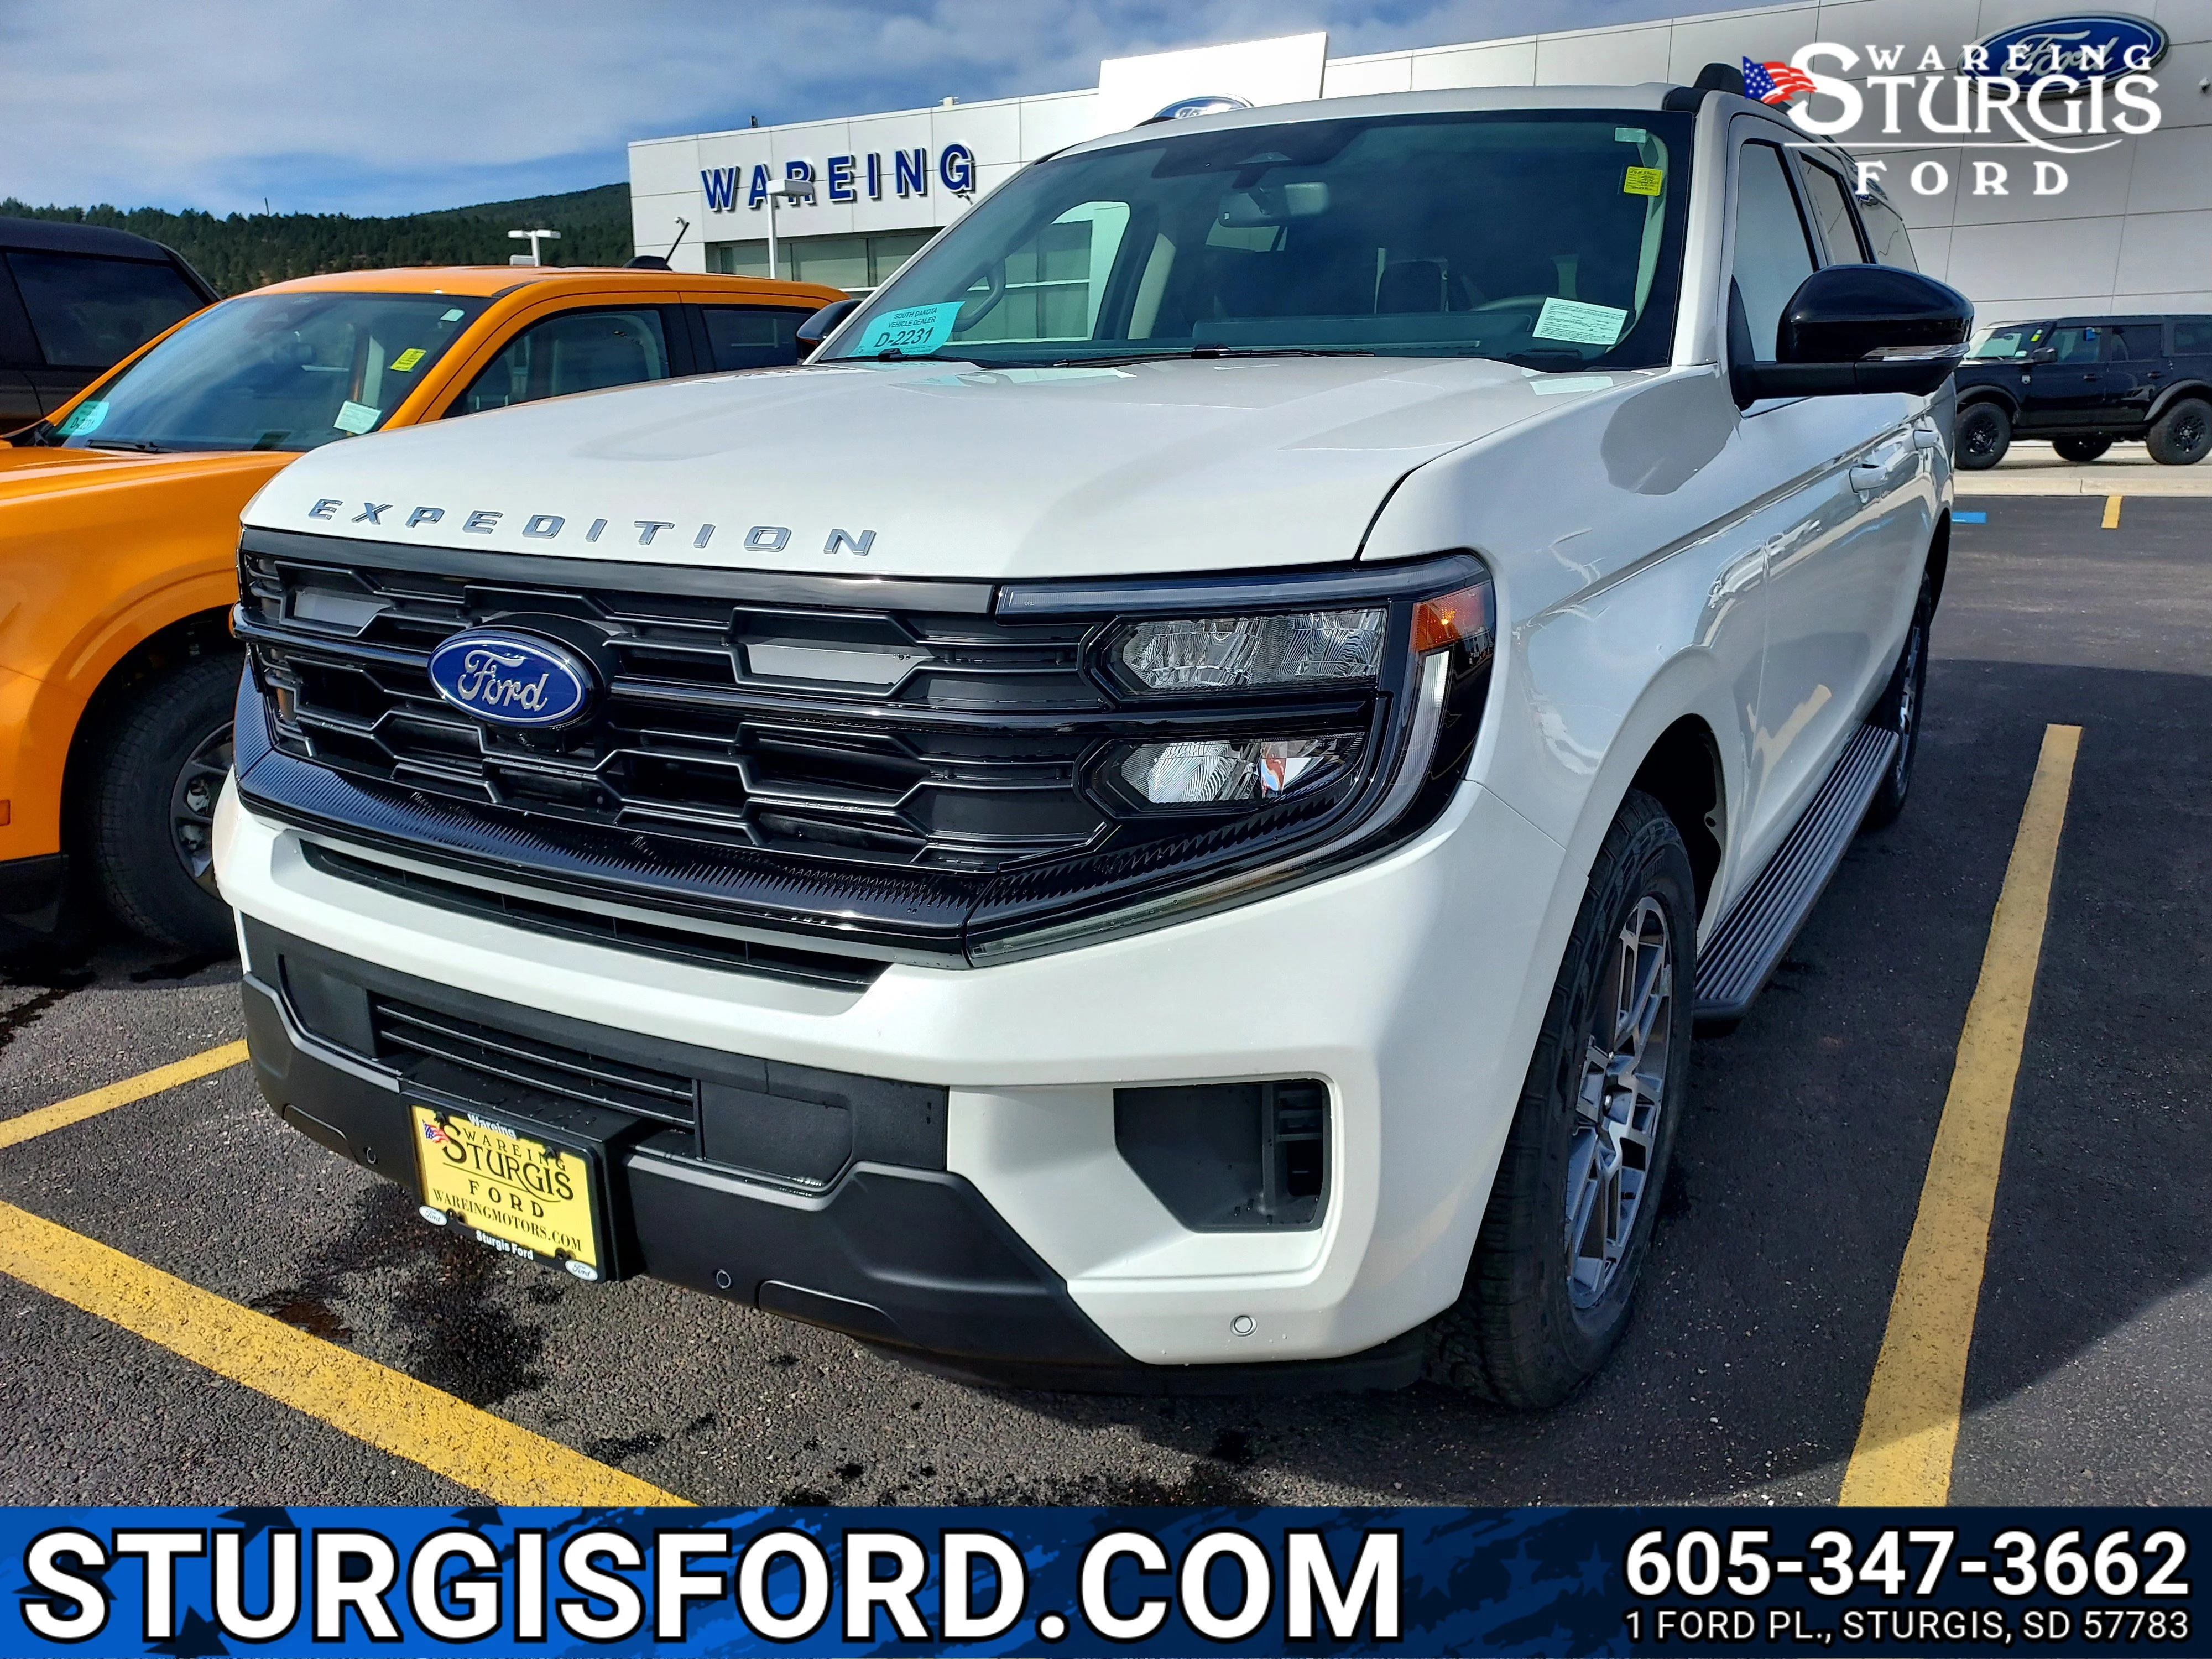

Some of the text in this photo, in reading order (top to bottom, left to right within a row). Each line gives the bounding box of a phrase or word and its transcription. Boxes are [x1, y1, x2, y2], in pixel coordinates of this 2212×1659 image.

[701, 143, 975, 212] WAREING
[888, 316, 936, 328] VEHICLE DEALER
[894, 307, 938, 320] SOUTH DAKOTA
[873, 327, 935, 348] D-2231
[307, 498, 877, 556] EXPEDITION
[456, 649, 549, 713] Ford
[467, 1113, 517, 1140] Wareing
[442, 1121, 574, 1203] STURGIS
[468, 1178, 544, 1218] FORD
[425, 1209, 442, 1223] Ford
[432, 1188, 582, 1253] WAREINGMOTORS.COM
[476, 1230, 534, 1261] Sturgis Ford
[572, 1264, 591, 1278] Ford
